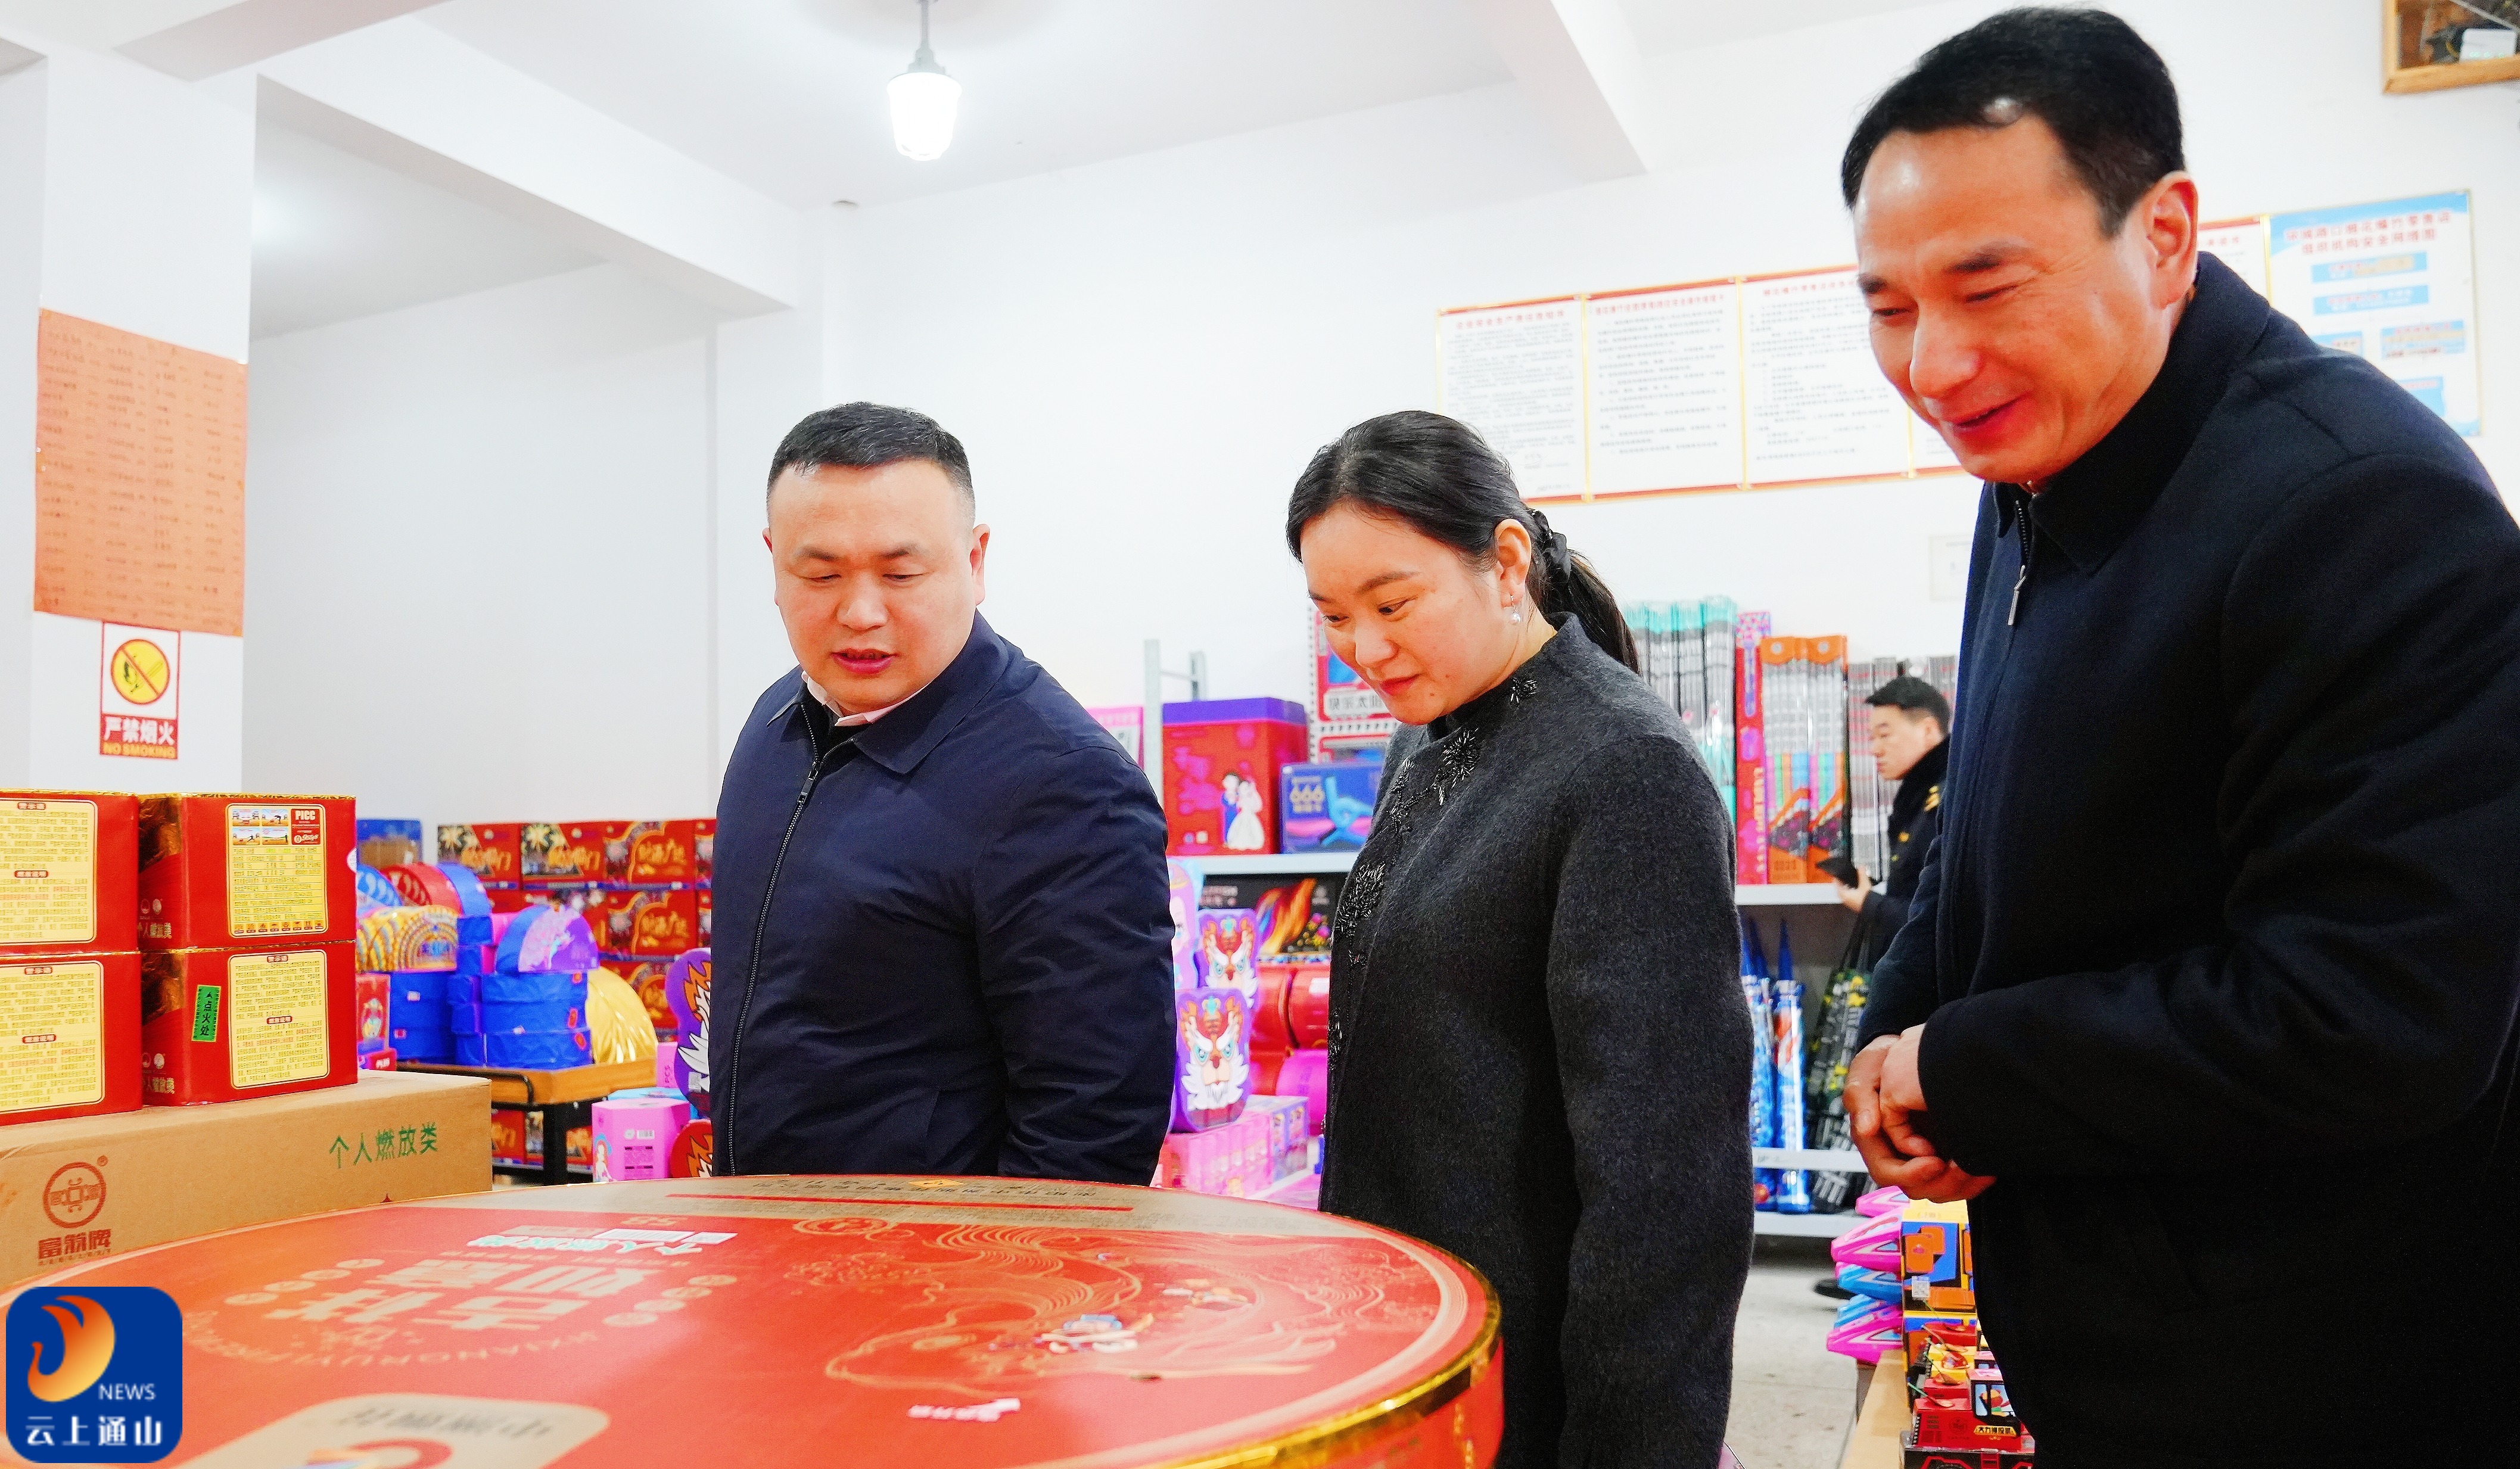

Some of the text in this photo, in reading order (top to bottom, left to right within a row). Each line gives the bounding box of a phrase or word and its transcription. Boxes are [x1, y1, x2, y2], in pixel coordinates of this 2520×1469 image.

[104, 717, 175, 744] 严禁烟火
[104, 745, 175, 759] NO SMOKING
[295, 810, 316, 820] PICC
[200, 1000, 212, 1036] 点火处
[328, 1122, 438, 1169] 个人燃放类
[466, 1234, 703, 1256] 个人燃放类
